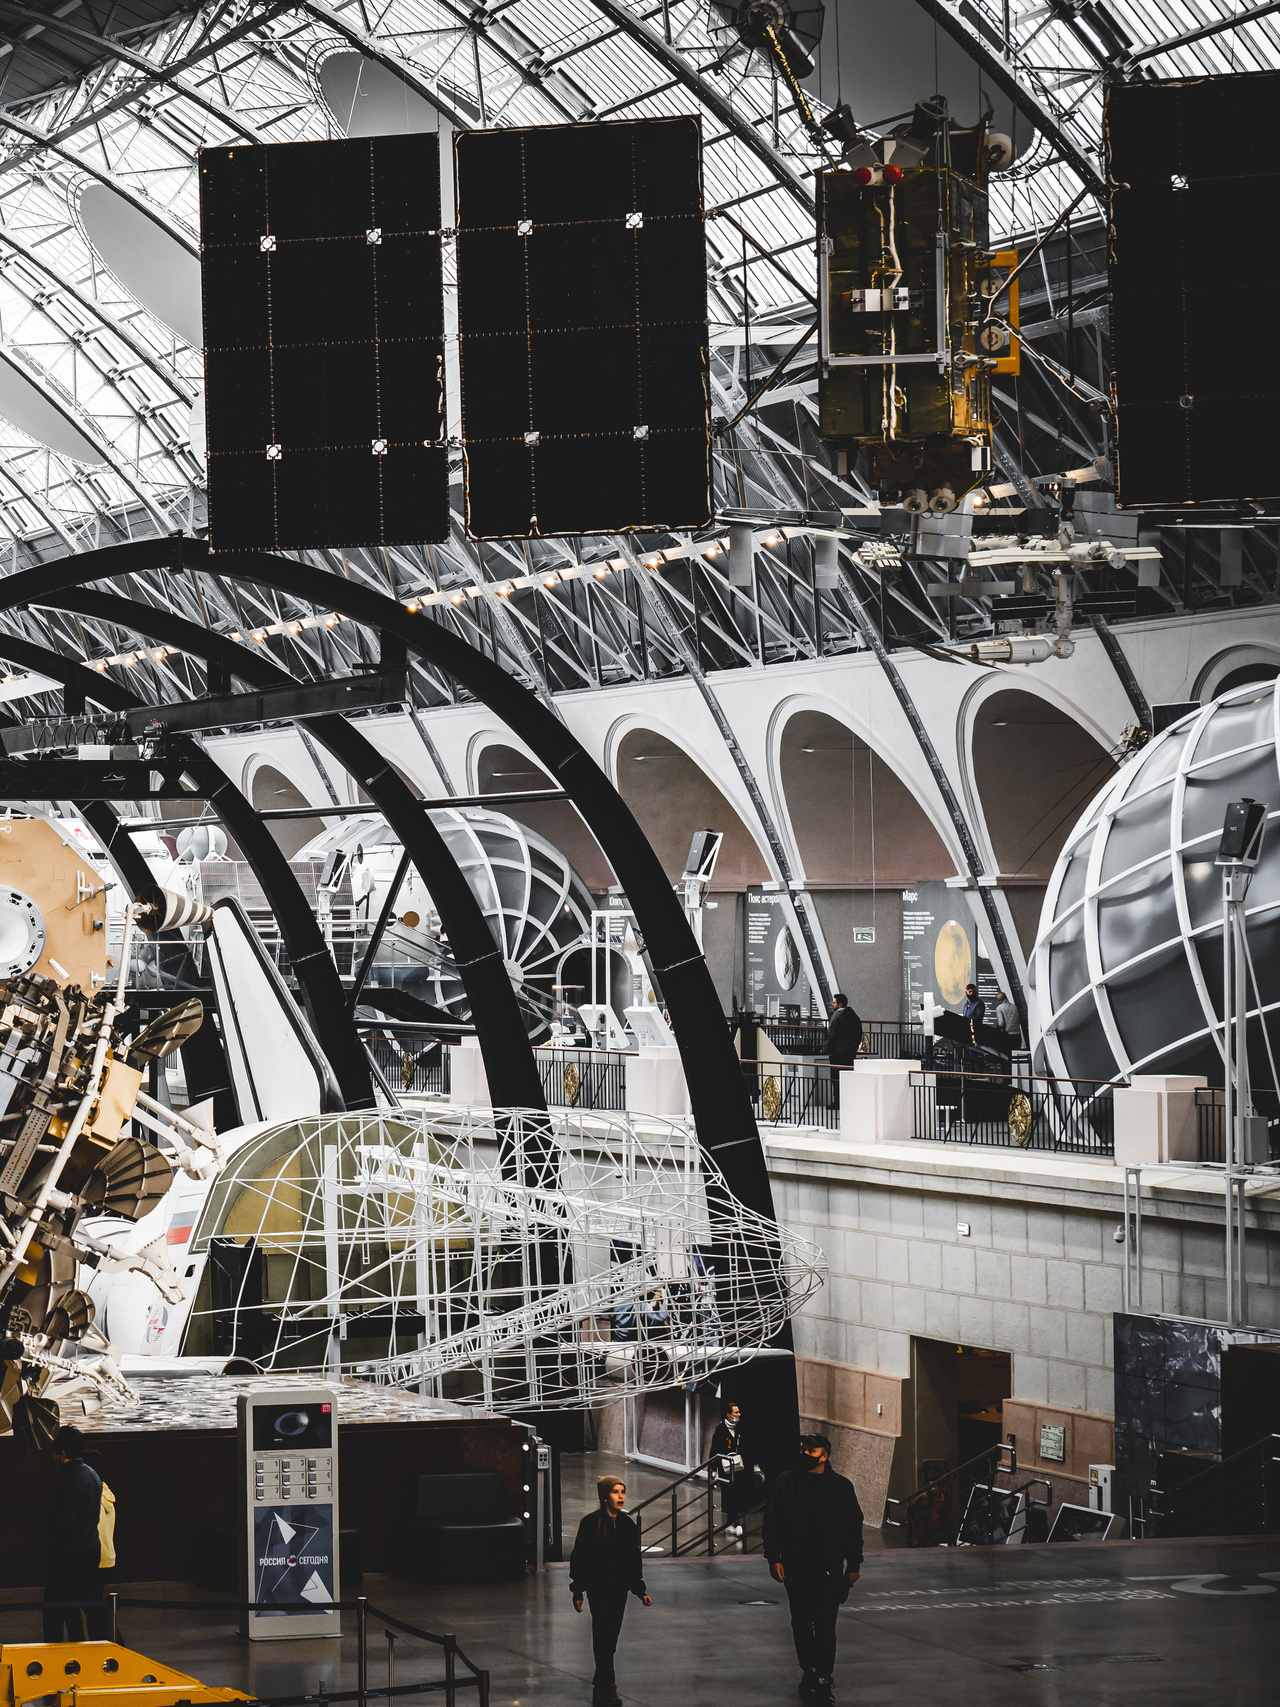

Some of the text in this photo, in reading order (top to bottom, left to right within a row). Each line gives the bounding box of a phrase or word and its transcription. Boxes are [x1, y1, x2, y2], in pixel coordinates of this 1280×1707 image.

[902, 890, 918, 903] Марс
[259, 1556, 328, 1566] РОССИЯ СЕГОДНЯ
